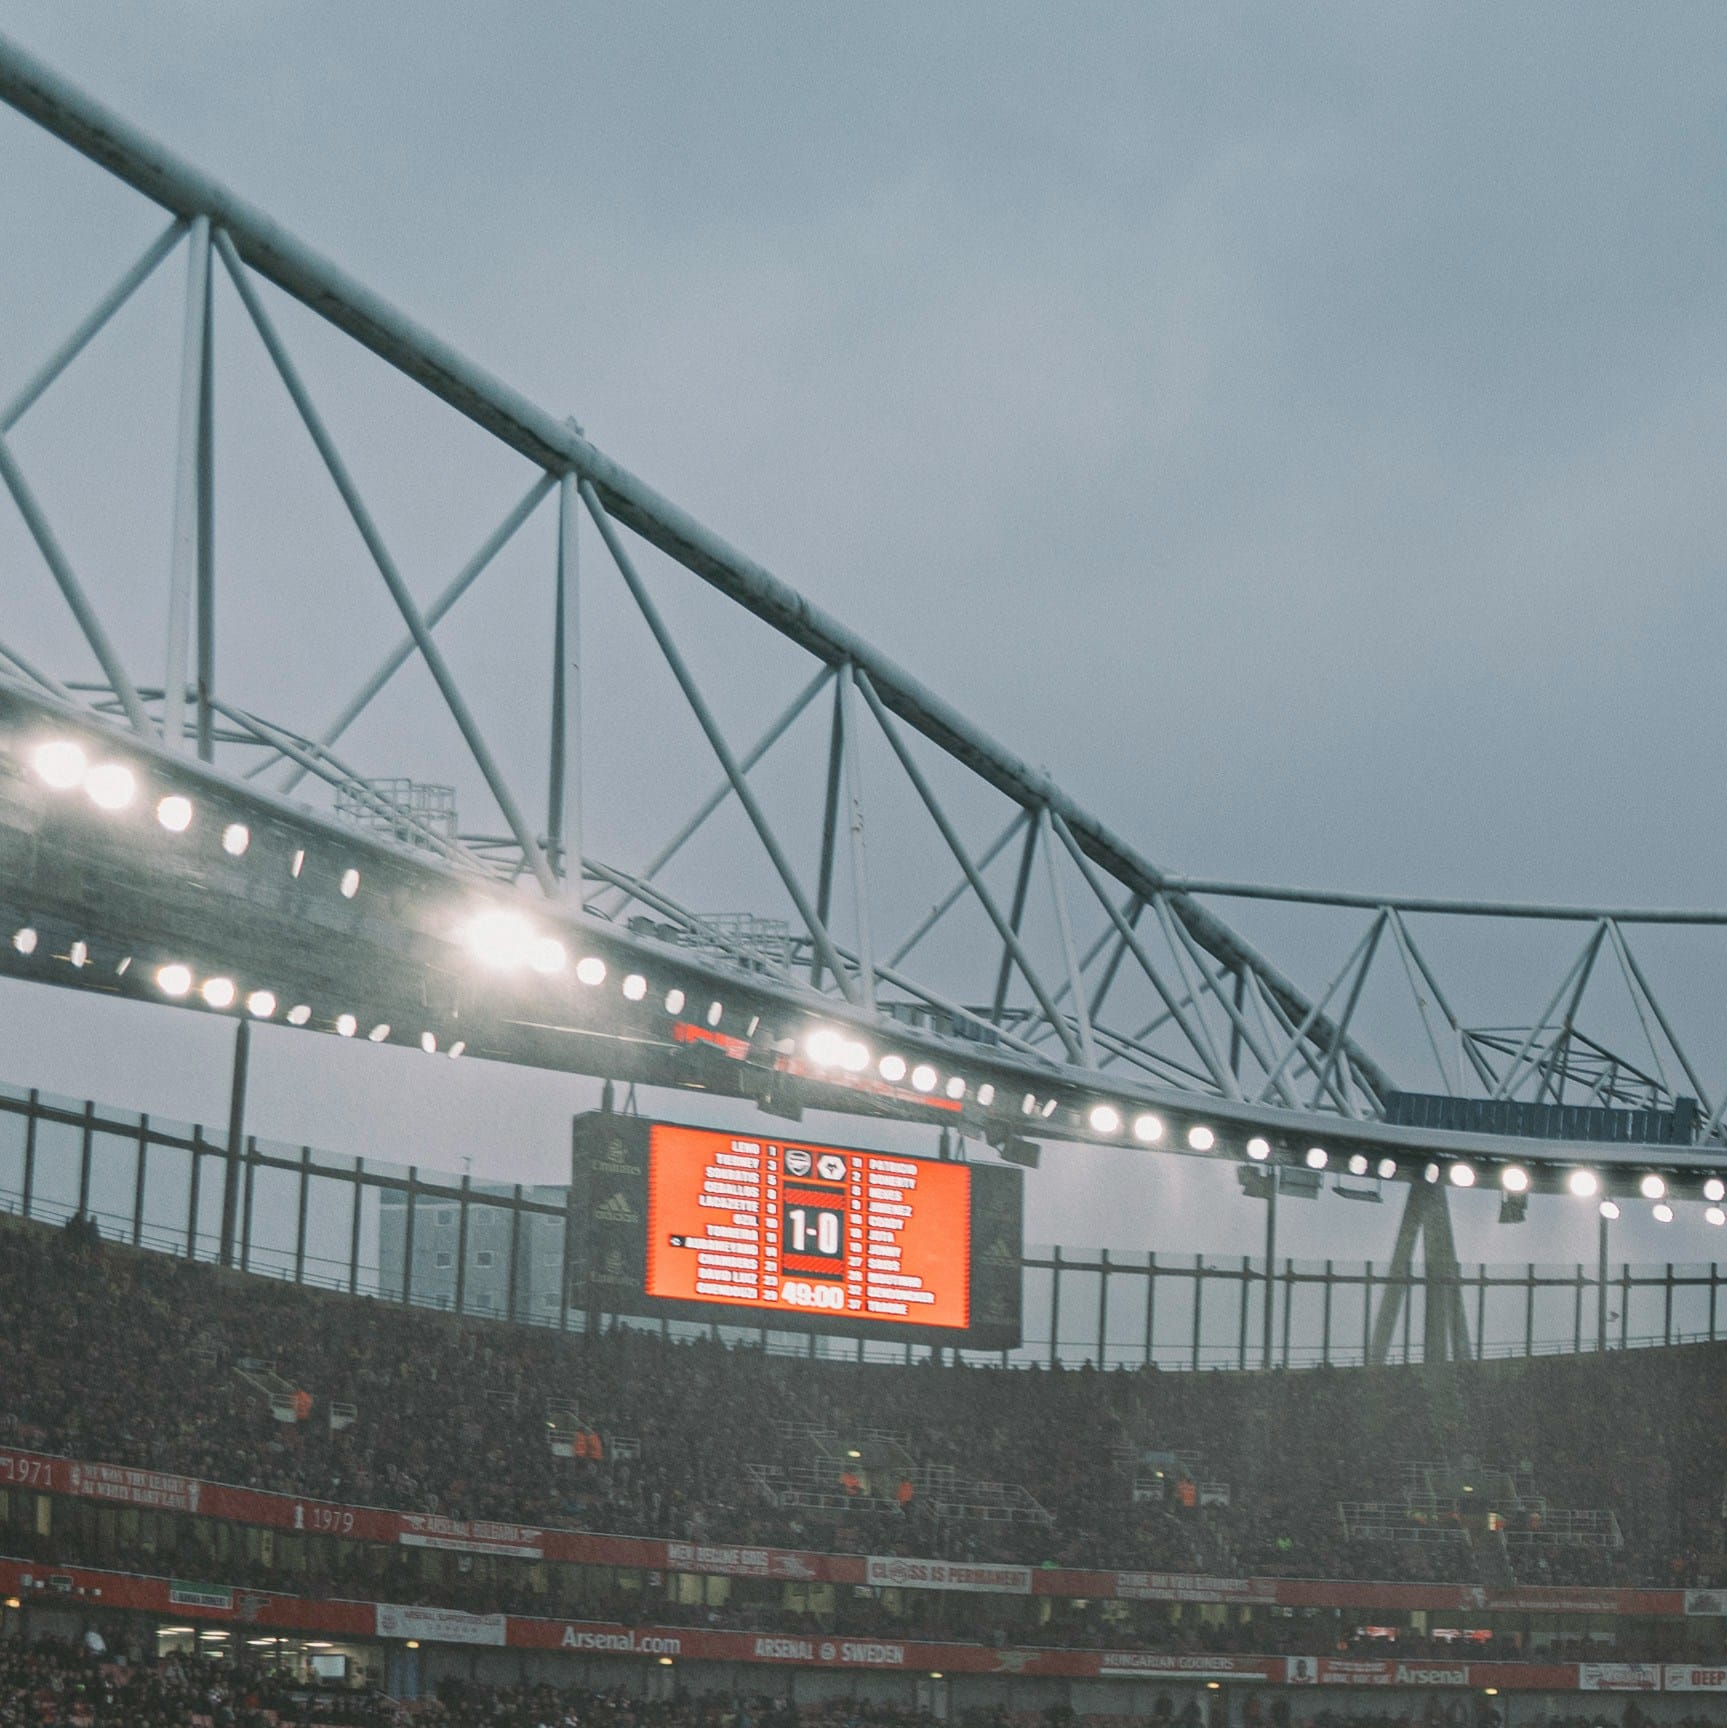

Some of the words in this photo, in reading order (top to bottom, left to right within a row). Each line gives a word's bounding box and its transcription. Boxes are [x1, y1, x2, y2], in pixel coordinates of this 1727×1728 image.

[789, 1210, 838, 1254] 1-0
[781, 1281, 844, 1309] 49:00
[314, 1507, 354, 1533] 1979
[561, 1626, 682, 1655] Arsenal.com
[755, 1639, 814, 1660] ARSENAL
[841, 1642, 904, 1664] SWEDEN
[1395, 1664, 1469, 1685] Arsenal
[1691, 1670, 1726, 1686] DEEP
